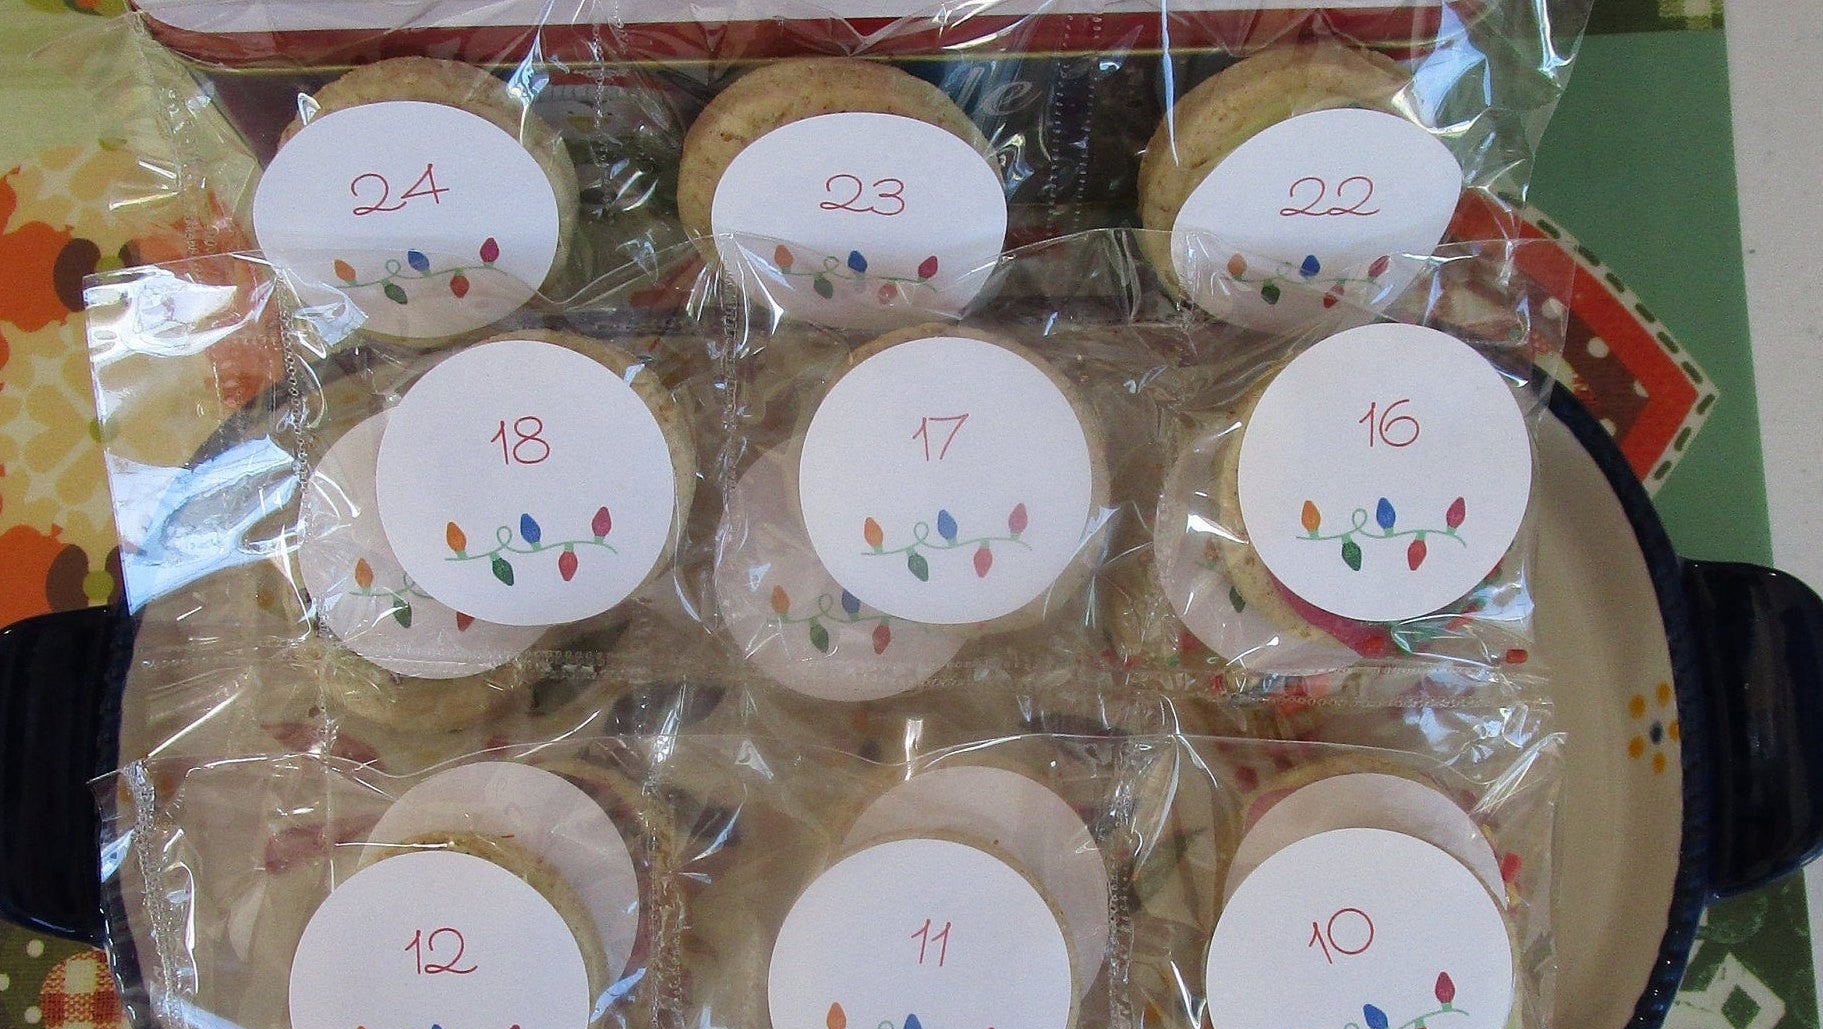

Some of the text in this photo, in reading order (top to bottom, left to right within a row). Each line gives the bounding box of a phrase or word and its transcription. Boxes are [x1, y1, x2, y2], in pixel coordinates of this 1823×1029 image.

[350, 164, 450, 216] 24
[819, 174, 905, 216] 23
[1279, 176, 1380, 217] 22
[490, 416, 550, 465] 18
[912, 413, 969, 461] 17
[1359, 399, 1420, 447] 16
[405, 927, 478, 975] 12
[911, 918, 951, 967] 11
[1308, 908, 1374, 964] 10
